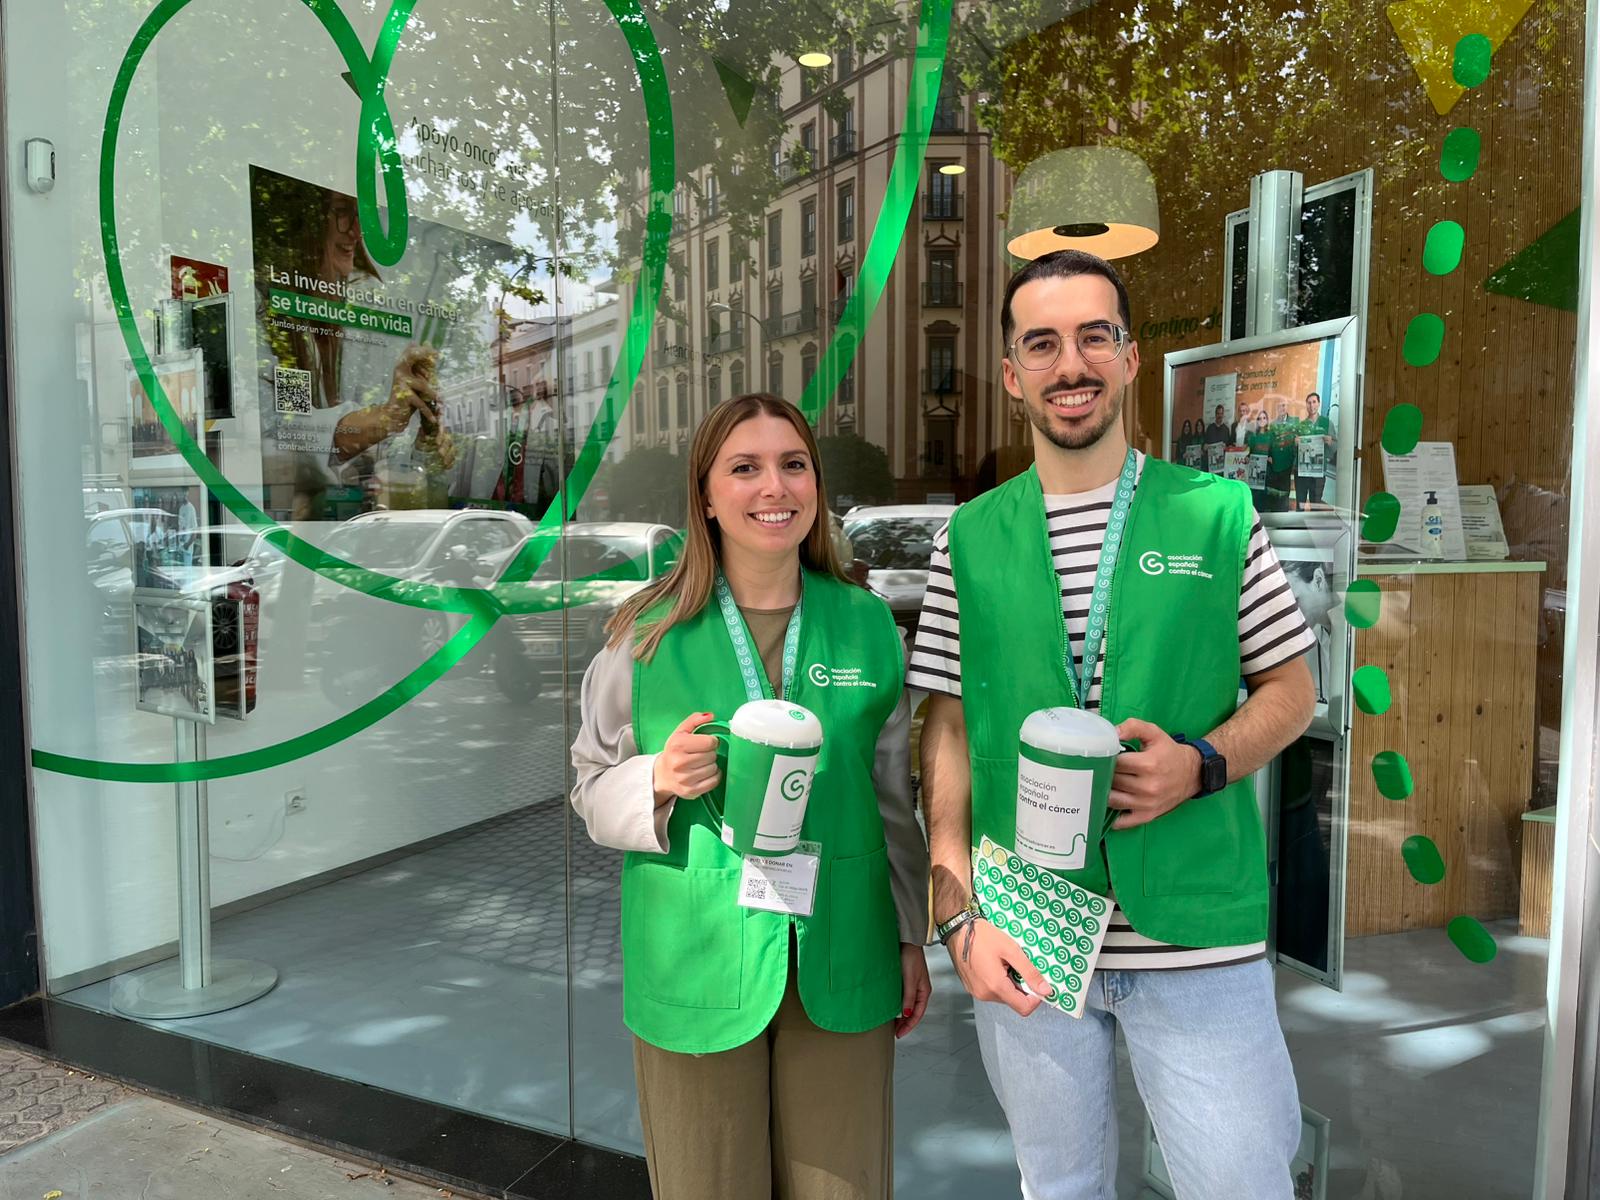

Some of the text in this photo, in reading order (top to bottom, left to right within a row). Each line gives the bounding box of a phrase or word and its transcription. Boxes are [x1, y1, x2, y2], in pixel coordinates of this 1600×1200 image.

[409, 116, 459, 153] Apoyo
[270, 265, 290, 285] La
[398, 296, 414, 312] en
[270, 318, 295, 331] Juntos
[295, 323, 309, 334] por
[309, 326, 319, 335] un
[271, 294, 411, 335] se traduce en vida
[1019, 793, 1081, 815] contra el cáncer
